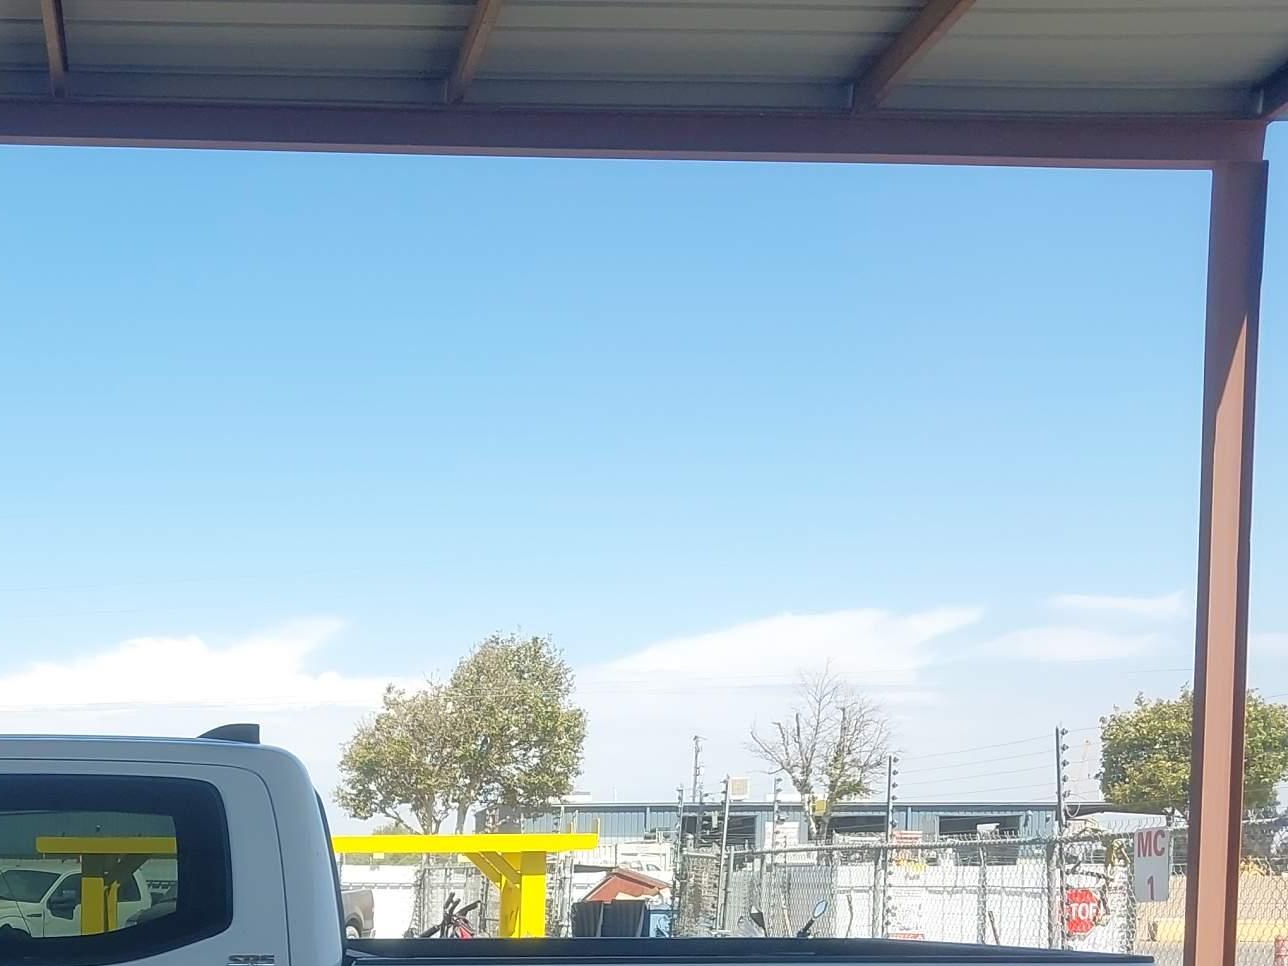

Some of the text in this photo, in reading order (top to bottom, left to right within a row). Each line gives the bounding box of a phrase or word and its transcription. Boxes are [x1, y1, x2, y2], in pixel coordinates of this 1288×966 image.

[1137, 830, 1165, 857] MC
[1146, 875, 1154, 900] 1
[1066, 902, 1098, 921] TOP
